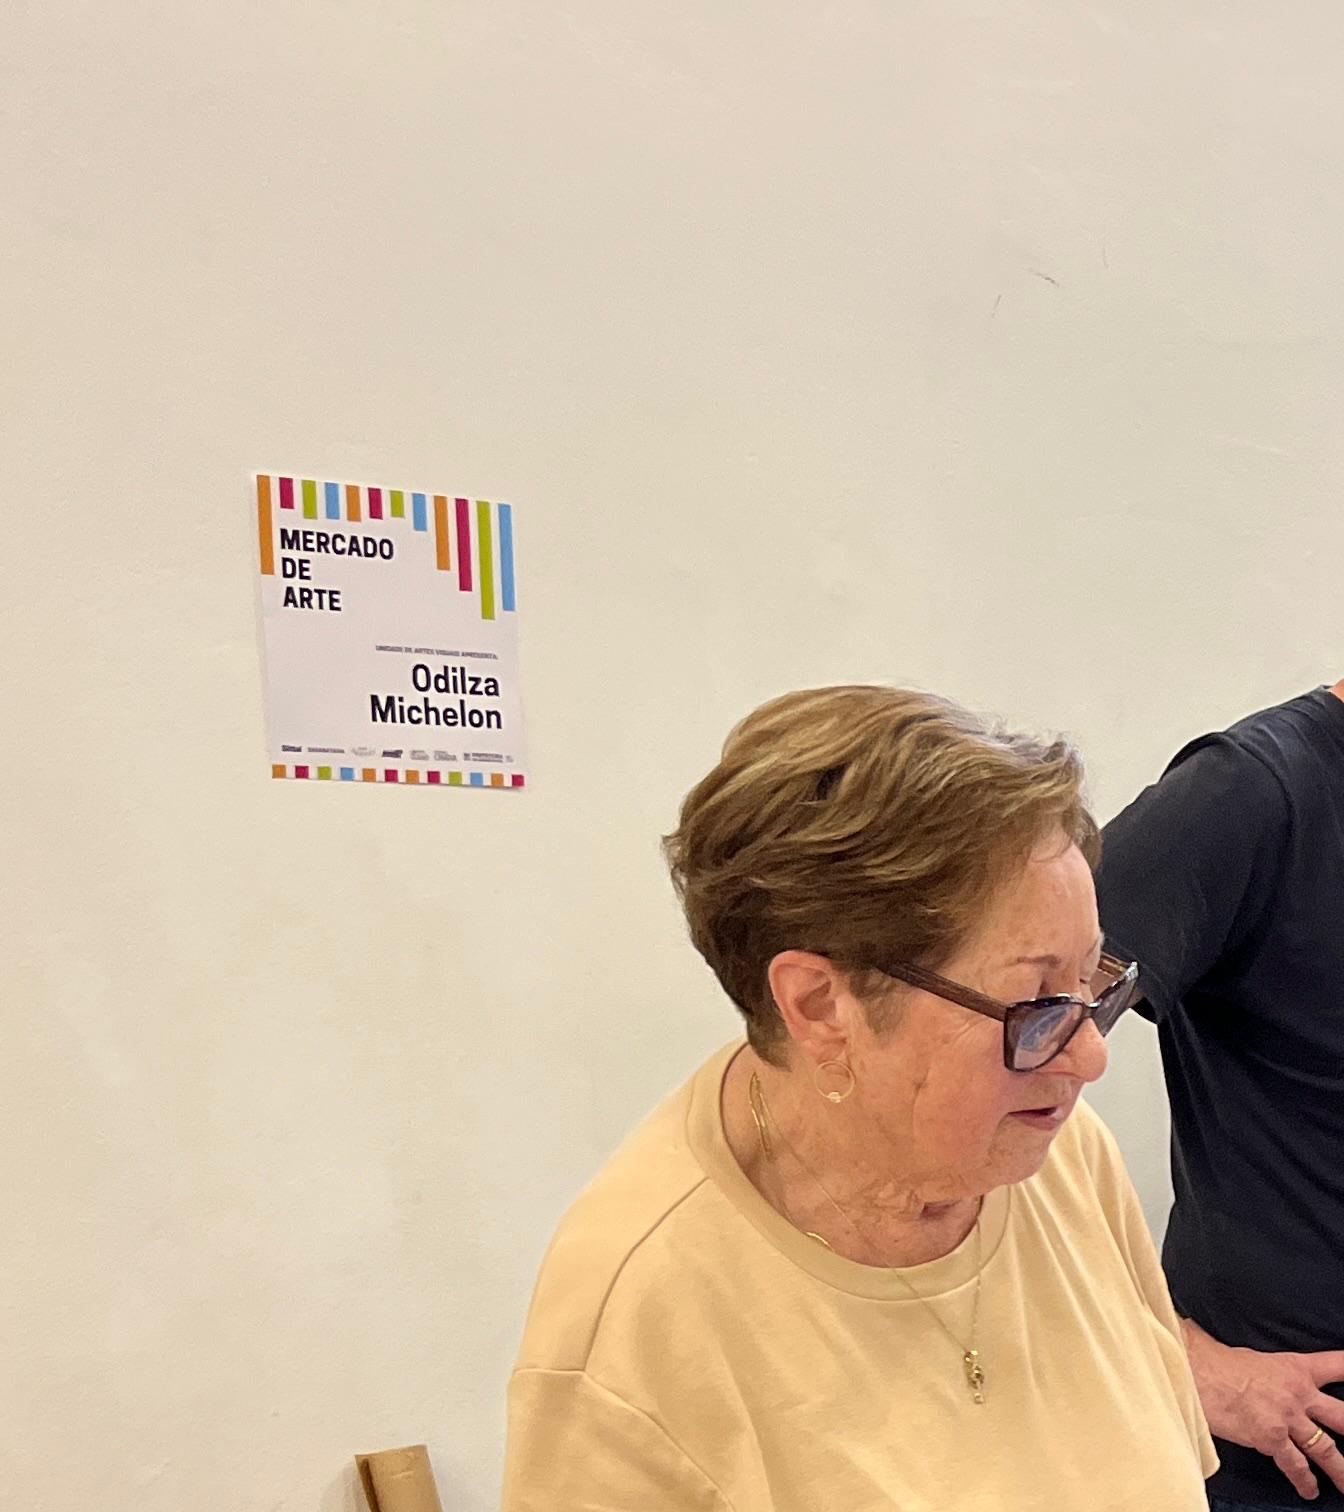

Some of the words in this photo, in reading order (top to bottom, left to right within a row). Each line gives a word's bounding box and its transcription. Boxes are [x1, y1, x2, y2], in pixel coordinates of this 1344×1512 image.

[280, 528, 394, 560] MERCADO
[281, 557, 311, 580] DE
[283, 586, 341, 612] ARTE
[412, 663, 500, 697] Odilza
[370, 694, 502, 730] Michelon
